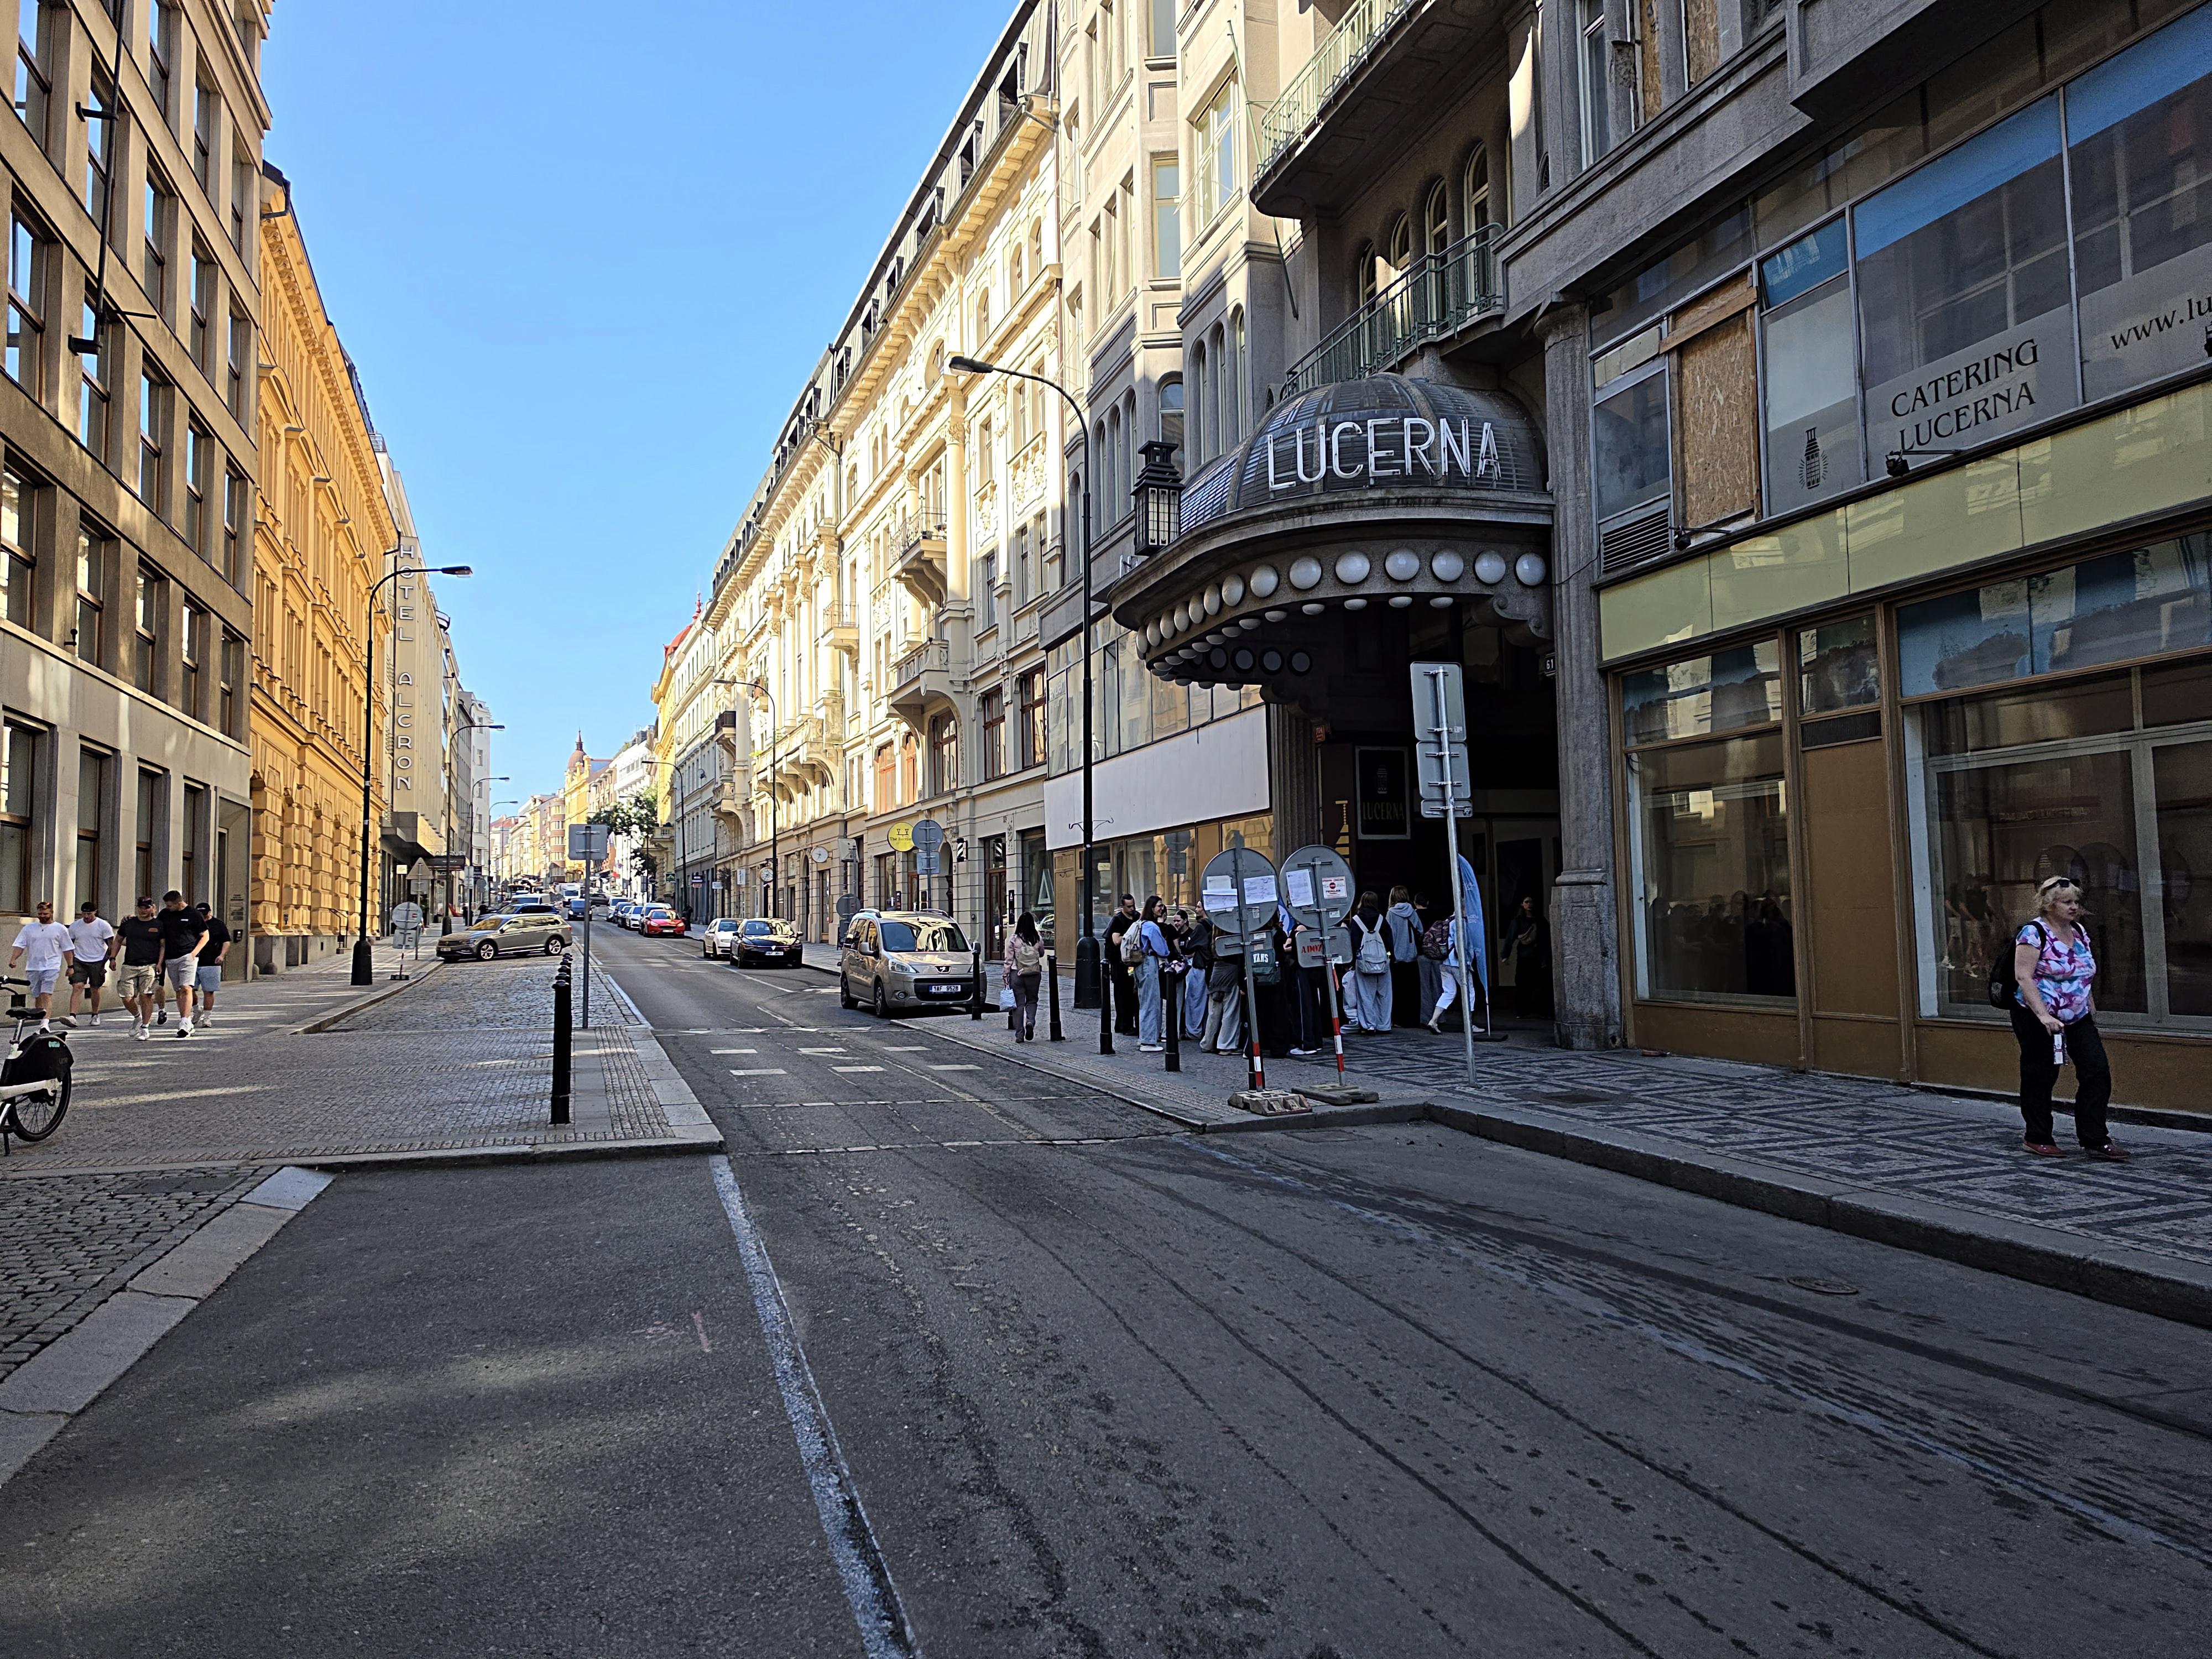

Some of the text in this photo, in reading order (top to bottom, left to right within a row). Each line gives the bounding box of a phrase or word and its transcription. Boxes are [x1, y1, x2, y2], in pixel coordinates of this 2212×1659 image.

[1891, 338, 2039, 417] CATERING
[1900, 382, 2036, 451] LUCERNA
[1267, 417, 1502, 491] LUCERNA
[397, 544, 415, 790] HOTEL ALCRON
[1546, 659, 1553, 670] 61
[1362, 801, 1405, 820] LUCERNA
[1253, 953, 1269, 963] VANS
